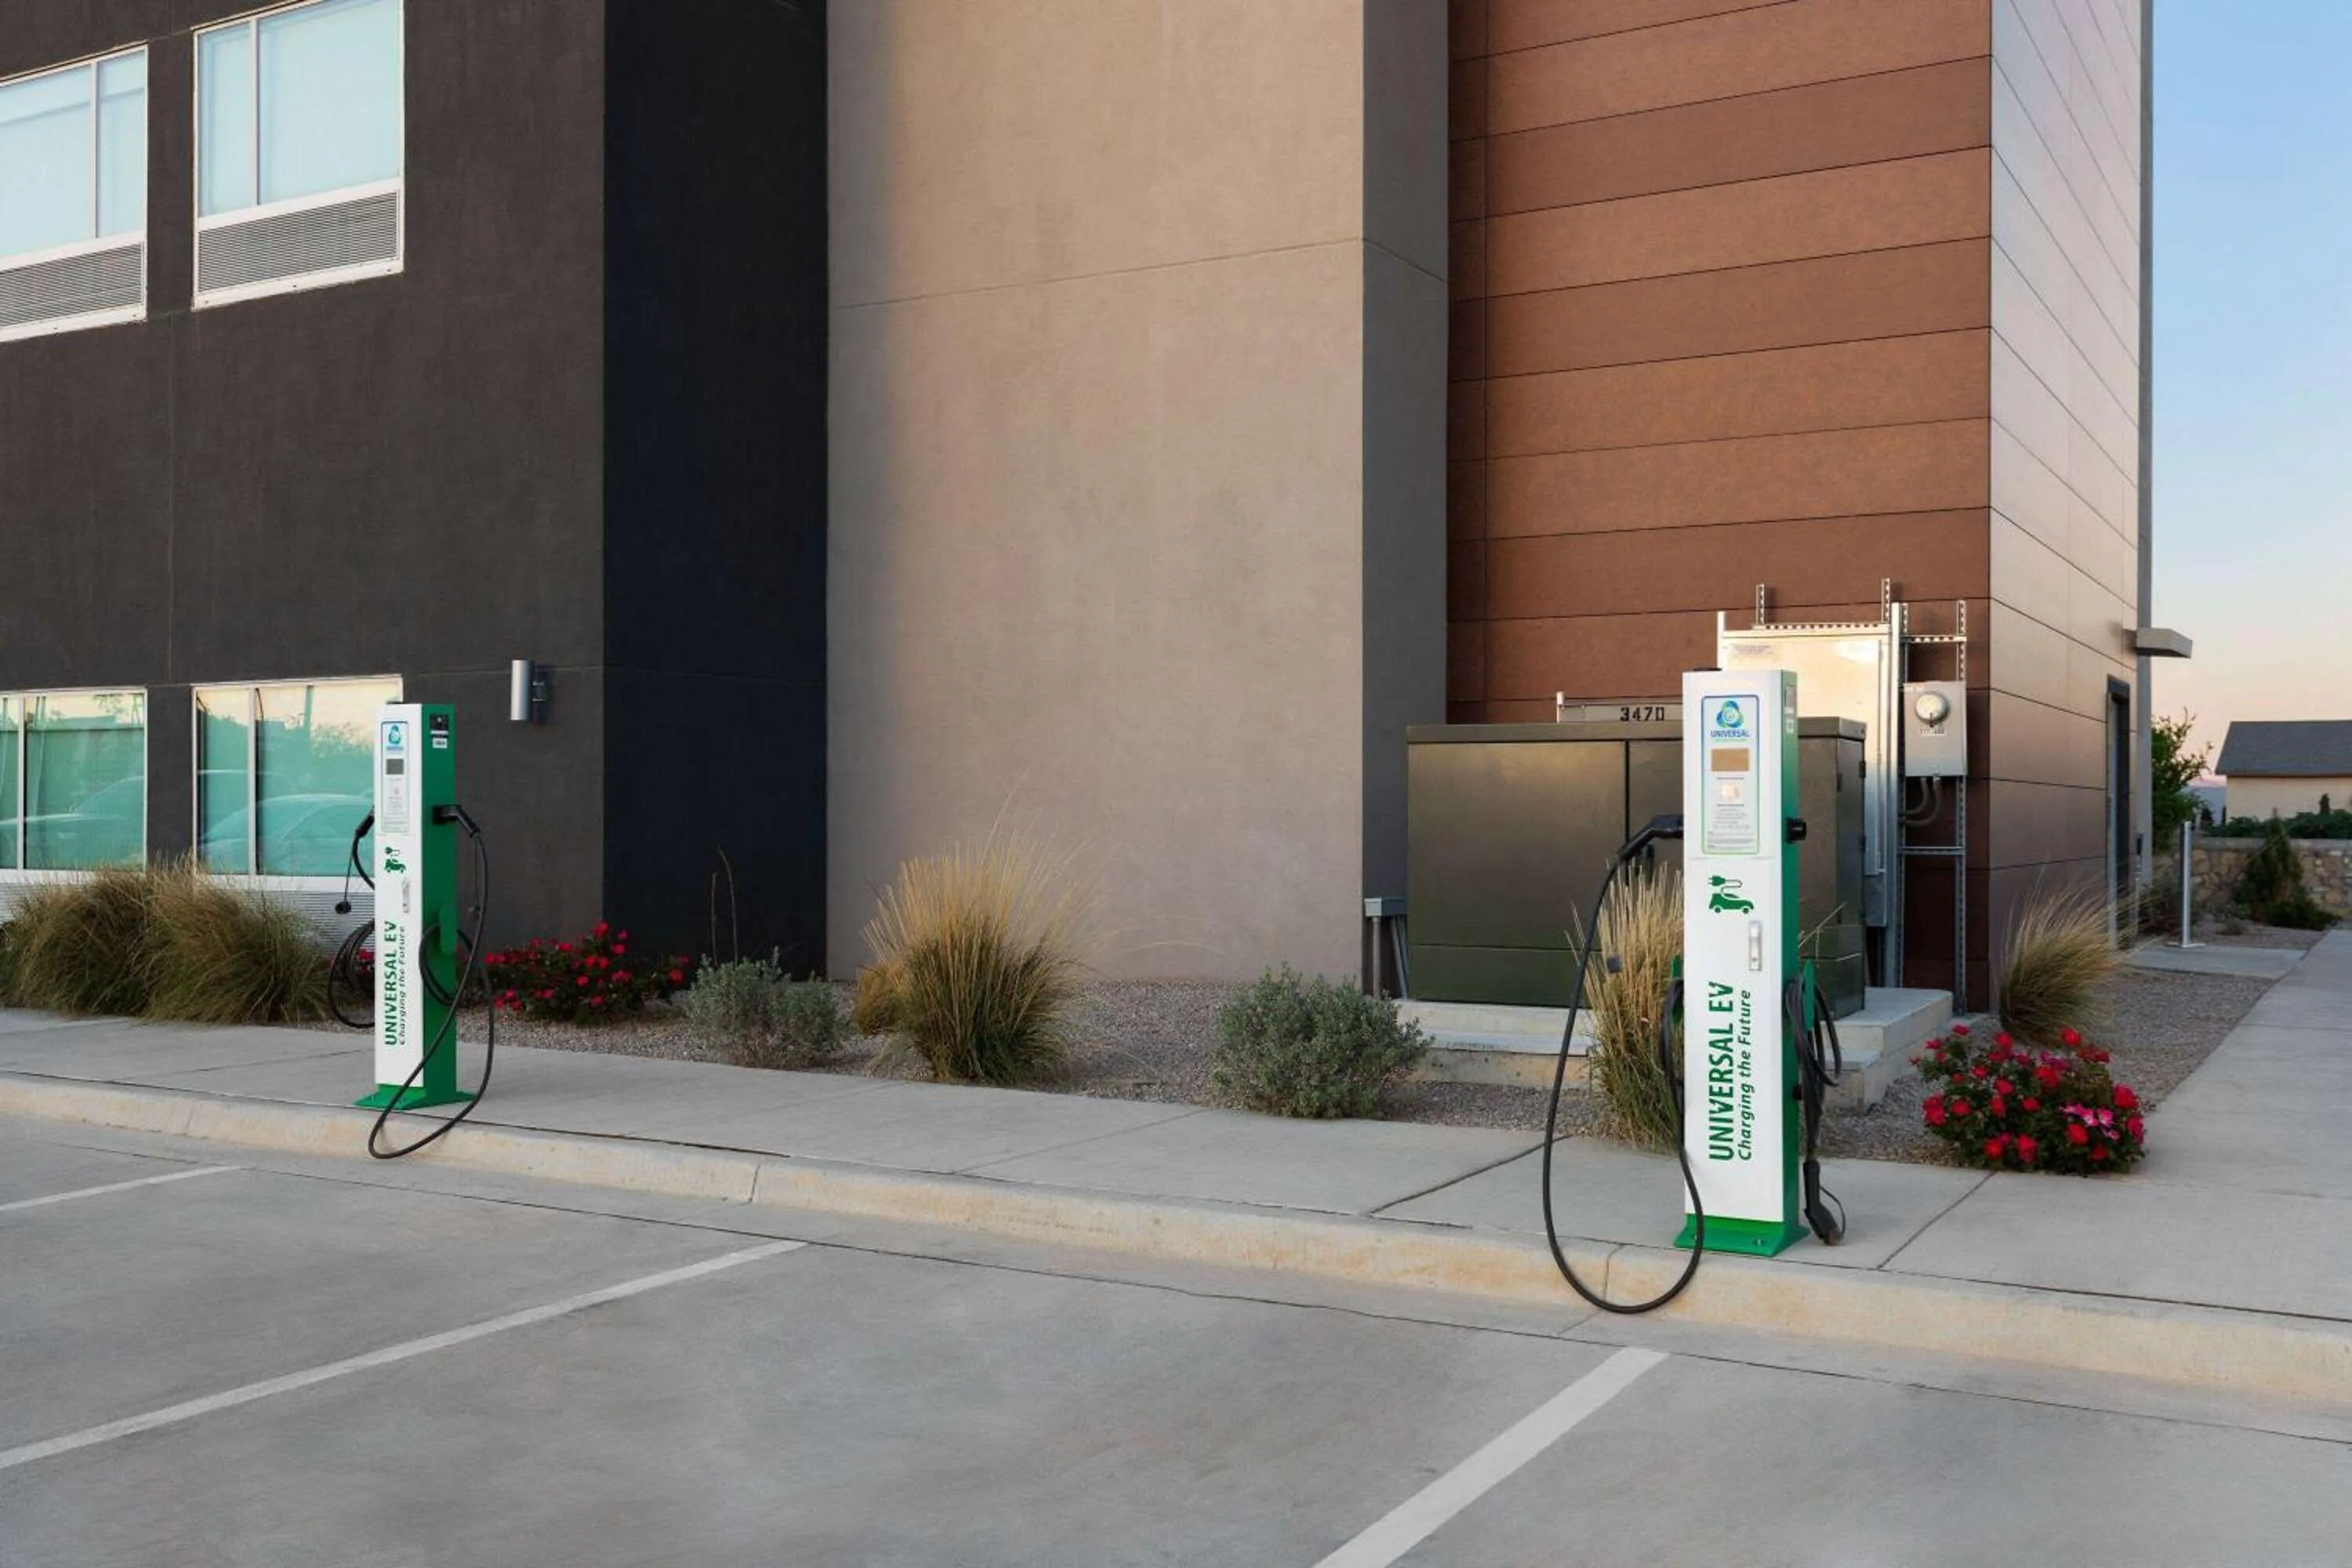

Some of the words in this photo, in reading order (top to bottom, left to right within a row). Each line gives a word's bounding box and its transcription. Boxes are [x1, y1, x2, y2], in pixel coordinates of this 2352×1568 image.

[1620, 706, 1664, 721] 3470
[384, 921, 397, 942] EV
[384, 951, 397, 1046] UNIVERSAL
[399, 990, 408, 1045] Charging
[1708, 981, 1734, 1013] EV
[1738, 990, 1751, 1046] Future
[1708, 1022, 1734, 1161] UNIVERSAL
[1737, 1050, 1751, 1078] the
[1737, 1083, 1755, 1161] Charging
